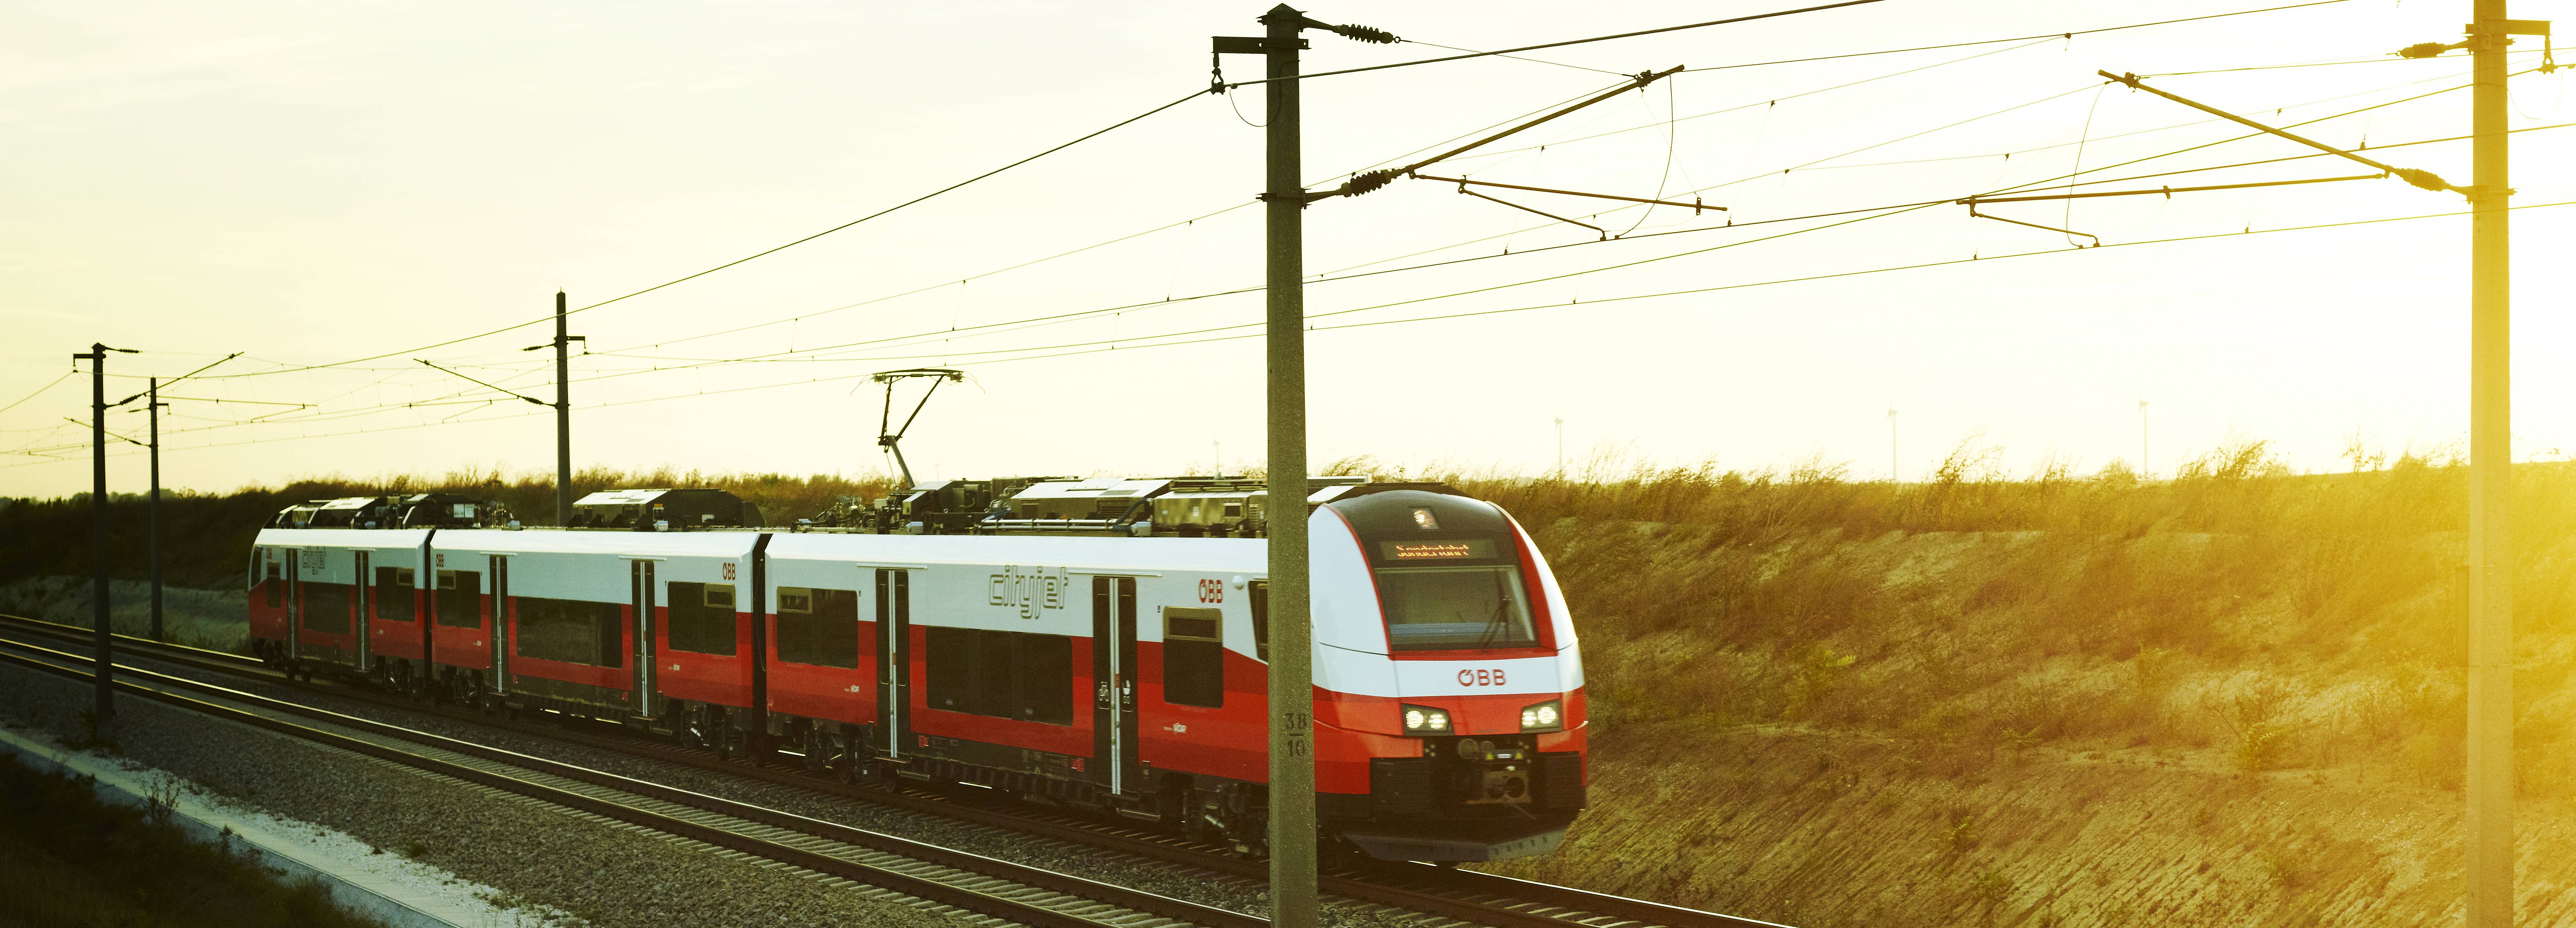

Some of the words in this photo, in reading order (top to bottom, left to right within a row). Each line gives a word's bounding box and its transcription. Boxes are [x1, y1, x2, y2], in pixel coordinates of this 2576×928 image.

[722, 562, 735, 580] ÖBB
[989, 565, 1068, 619] cityjet
[1199, 579, 1223, 603] ÖBB
[1458, 669, 1506, 687] ÖBB
[1285, 713, 1307, 730] 38
[1288, 739, 1305, 757] 10
